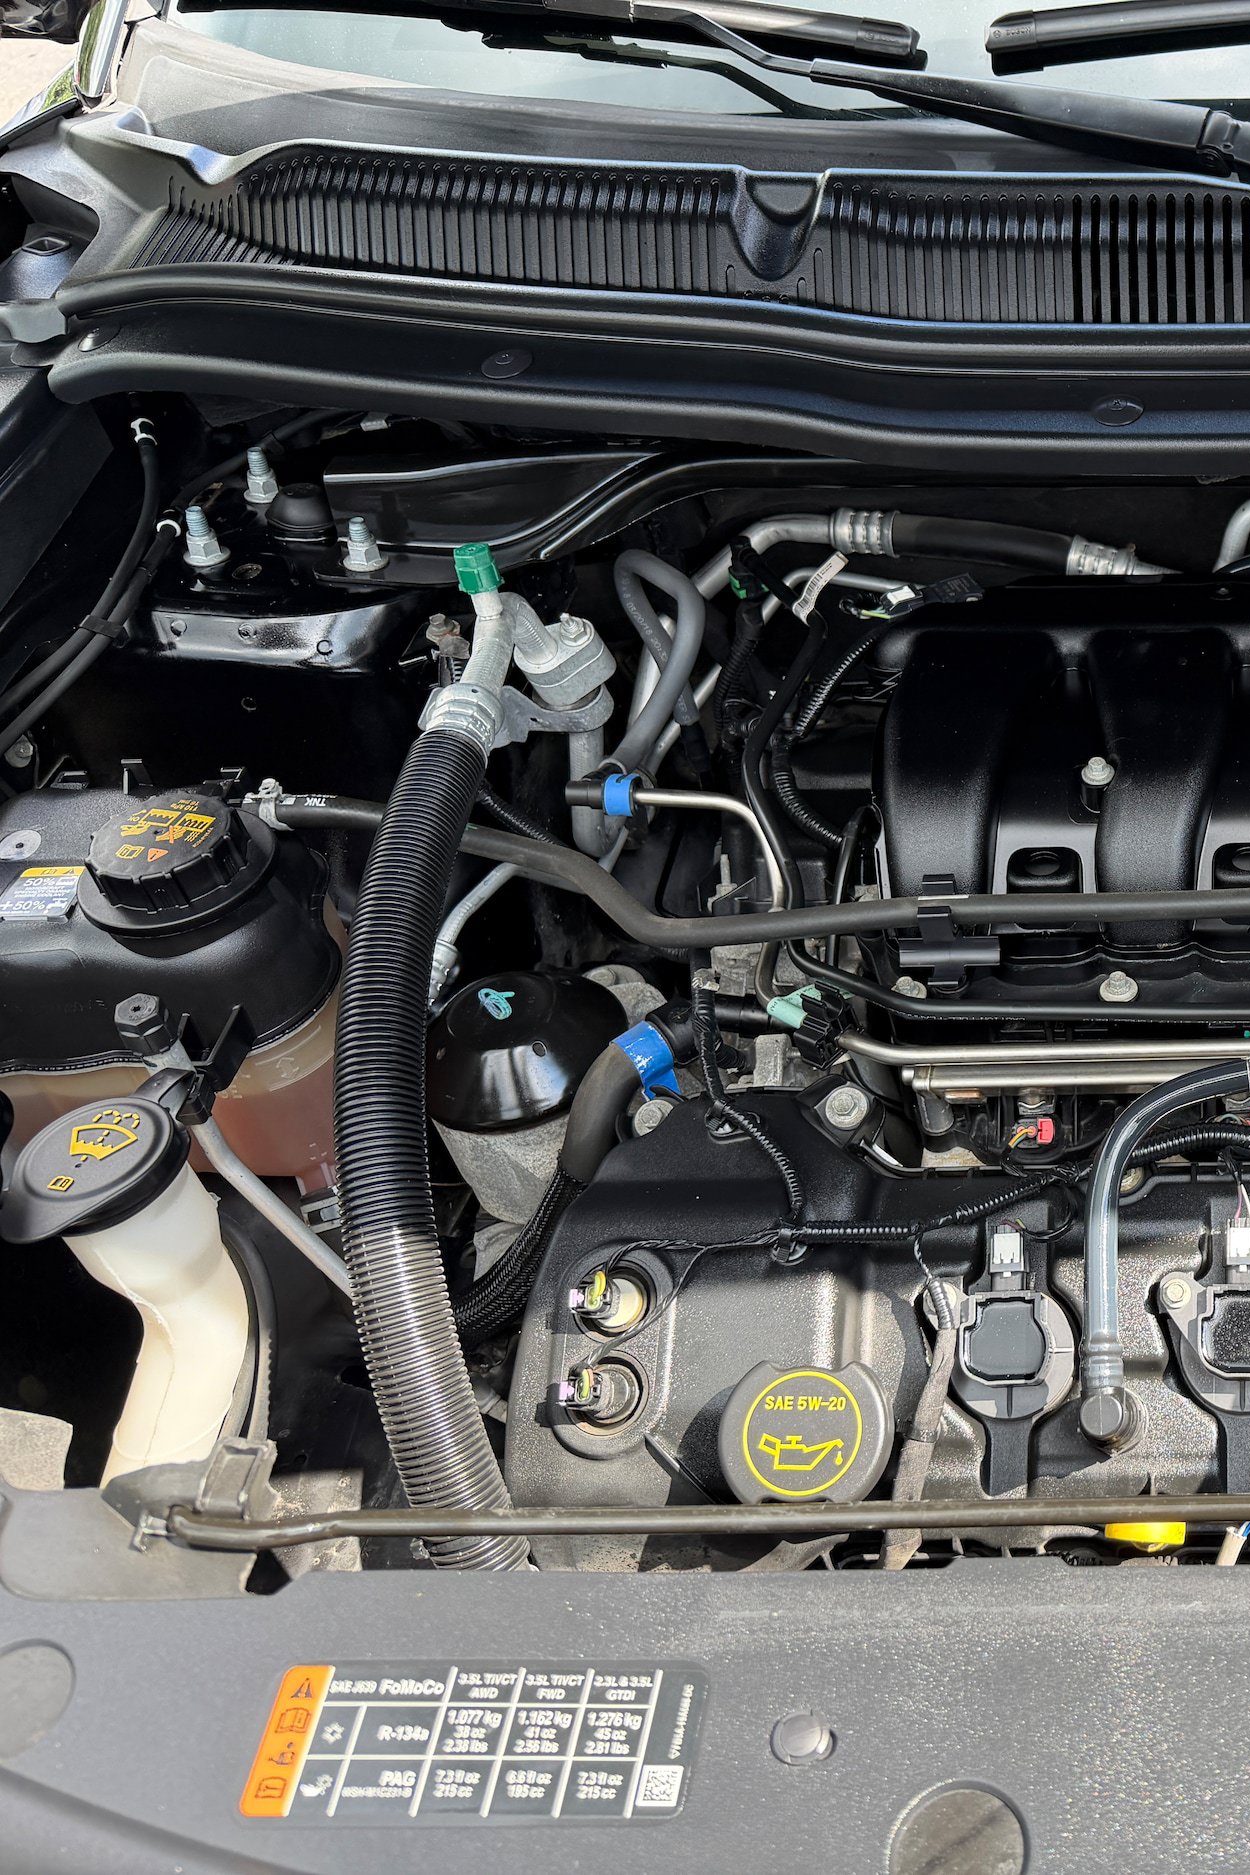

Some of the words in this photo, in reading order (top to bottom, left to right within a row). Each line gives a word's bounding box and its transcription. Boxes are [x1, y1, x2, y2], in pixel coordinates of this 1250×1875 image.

[304, 797, 327, 807] TNK
[23, 878, 55, 886] 50%
[764, 1396, 794, 1411] SAE
[797, 1396, 847, 1411] 5W-20
[458, 1673, 482, 1686] 3.5L
[525, 1674, 550, 1687] 3.5L
[629, 1676, 653, 1688] 3.5L
[330, 1680, 353, 1694] SAE
[378, 1678, 445, 1695] FoMoCo
[467, 1687, 499, 1699] AWD
[536, 1688, 566, 1700] FWD
[447, 1710, 483, 1725] 1.077
[483, 1710, 502, 1728] kg
[517, 1710, 553, 1725] 1.162
[553, 1710, 572, 1729] kg
[587, 1712, 623, 1726] 1.276
[623, 1712, 642, 1730] kg
[376, 1724, 430, 1741] R-134a
[470, 1727, 487, 1739] oz
[524, 1726, 540, 1739] 41
[540, 1728, 557, 1740] oz
[594, 1727, 612, 1740] 45
[611, 1729, 628, 1741] oz
[469, 1739, 489, 1753] lbs
[540, 1740, 560, 1753] lbs
[584, 1740, 610, 1754] 2.81
[610, 1741, 630, 1755] lbs
[378, 1770, 417, 1786] PAG
[464, 1772, 481, 1784] oz
[536, 1772, 552, 1785] oz
[608, 1774, 624, 1786] oz
[433, 1783, 457, 1798] 215
[457, 1786, 474, 1798] cc
[529, 1786, 546, 1798] cc
[576, 1785, 601, 1799] 215
[601, 1787, 616, 1799] cc
